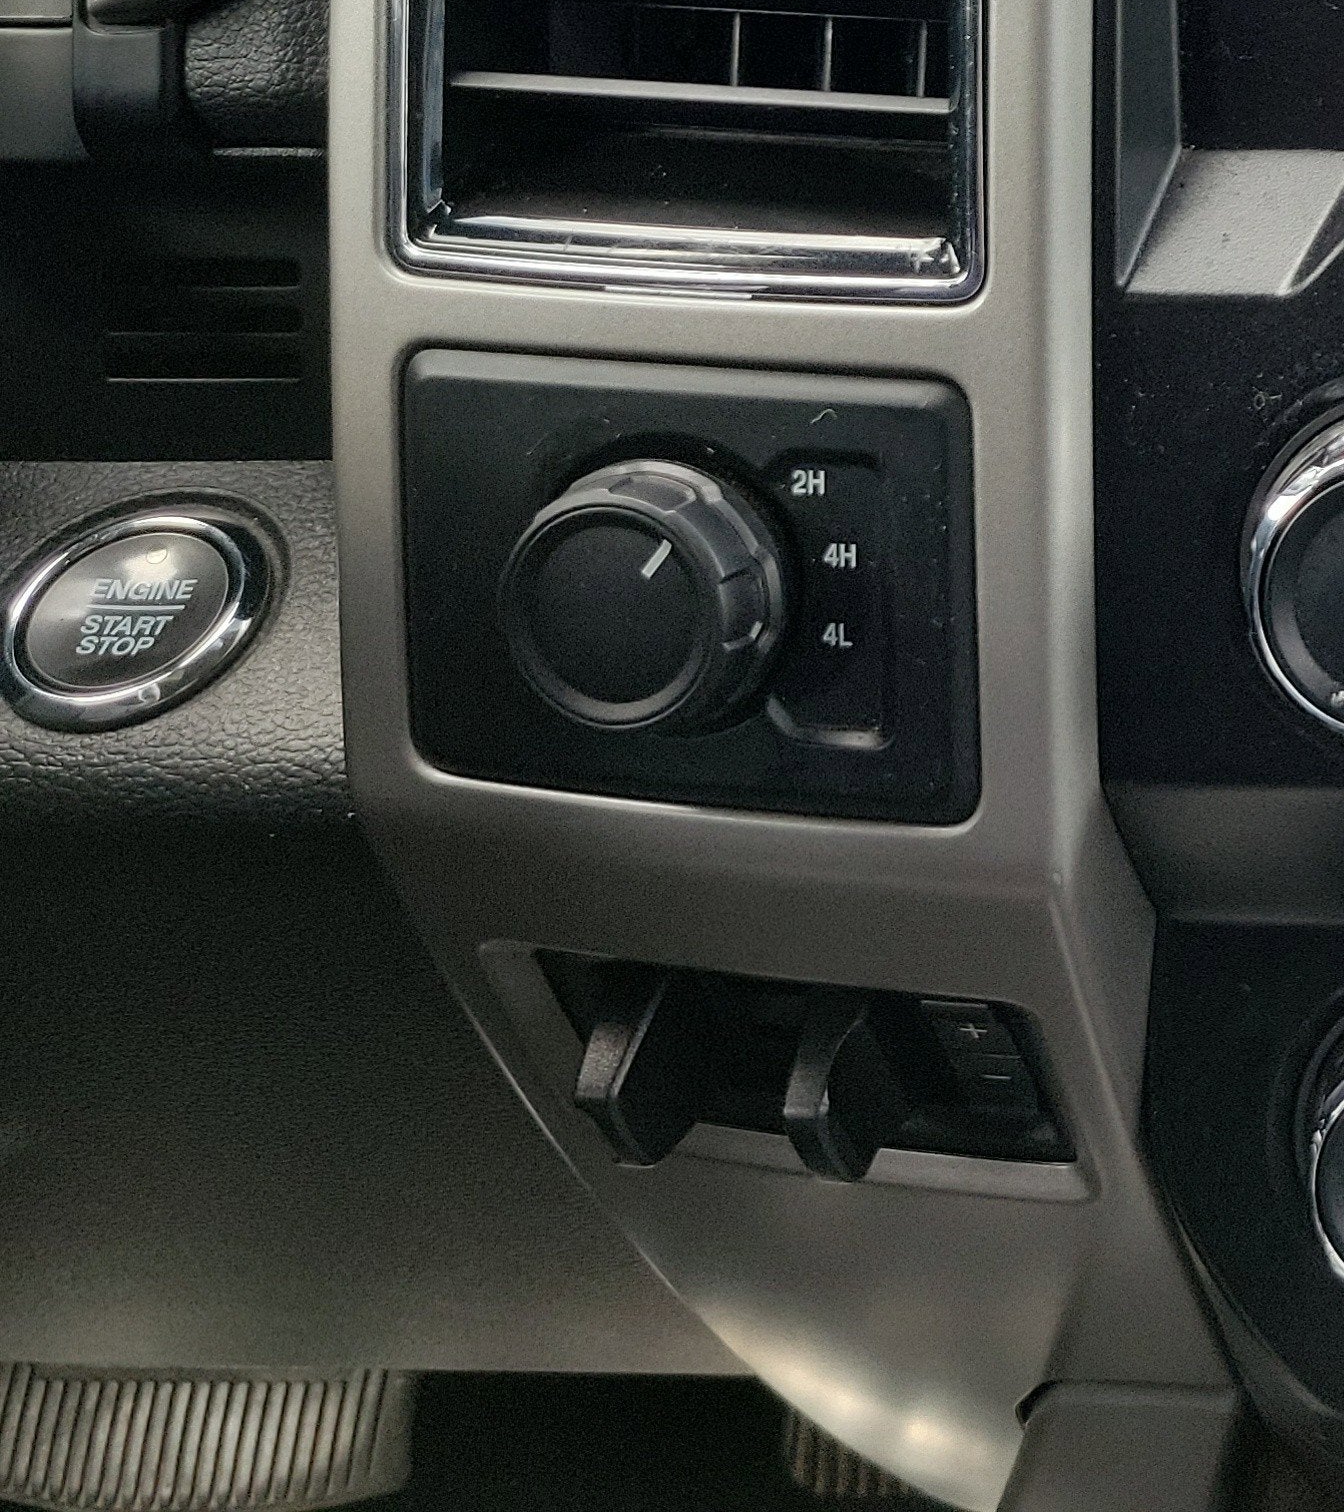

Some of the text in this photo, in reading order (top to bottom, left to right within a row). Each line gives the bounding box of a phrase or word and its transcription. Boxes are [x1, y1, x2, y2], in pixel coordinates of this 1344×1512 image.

[791, 469, 825, 496] 2H
[823, 543, 857, 569] 4H
[92, 578, 199, 600] ENGINE
[80, 615, 174, 636] START
[822, 622, 853, 647] 4L
[75, 636, 155, 656] STOP
